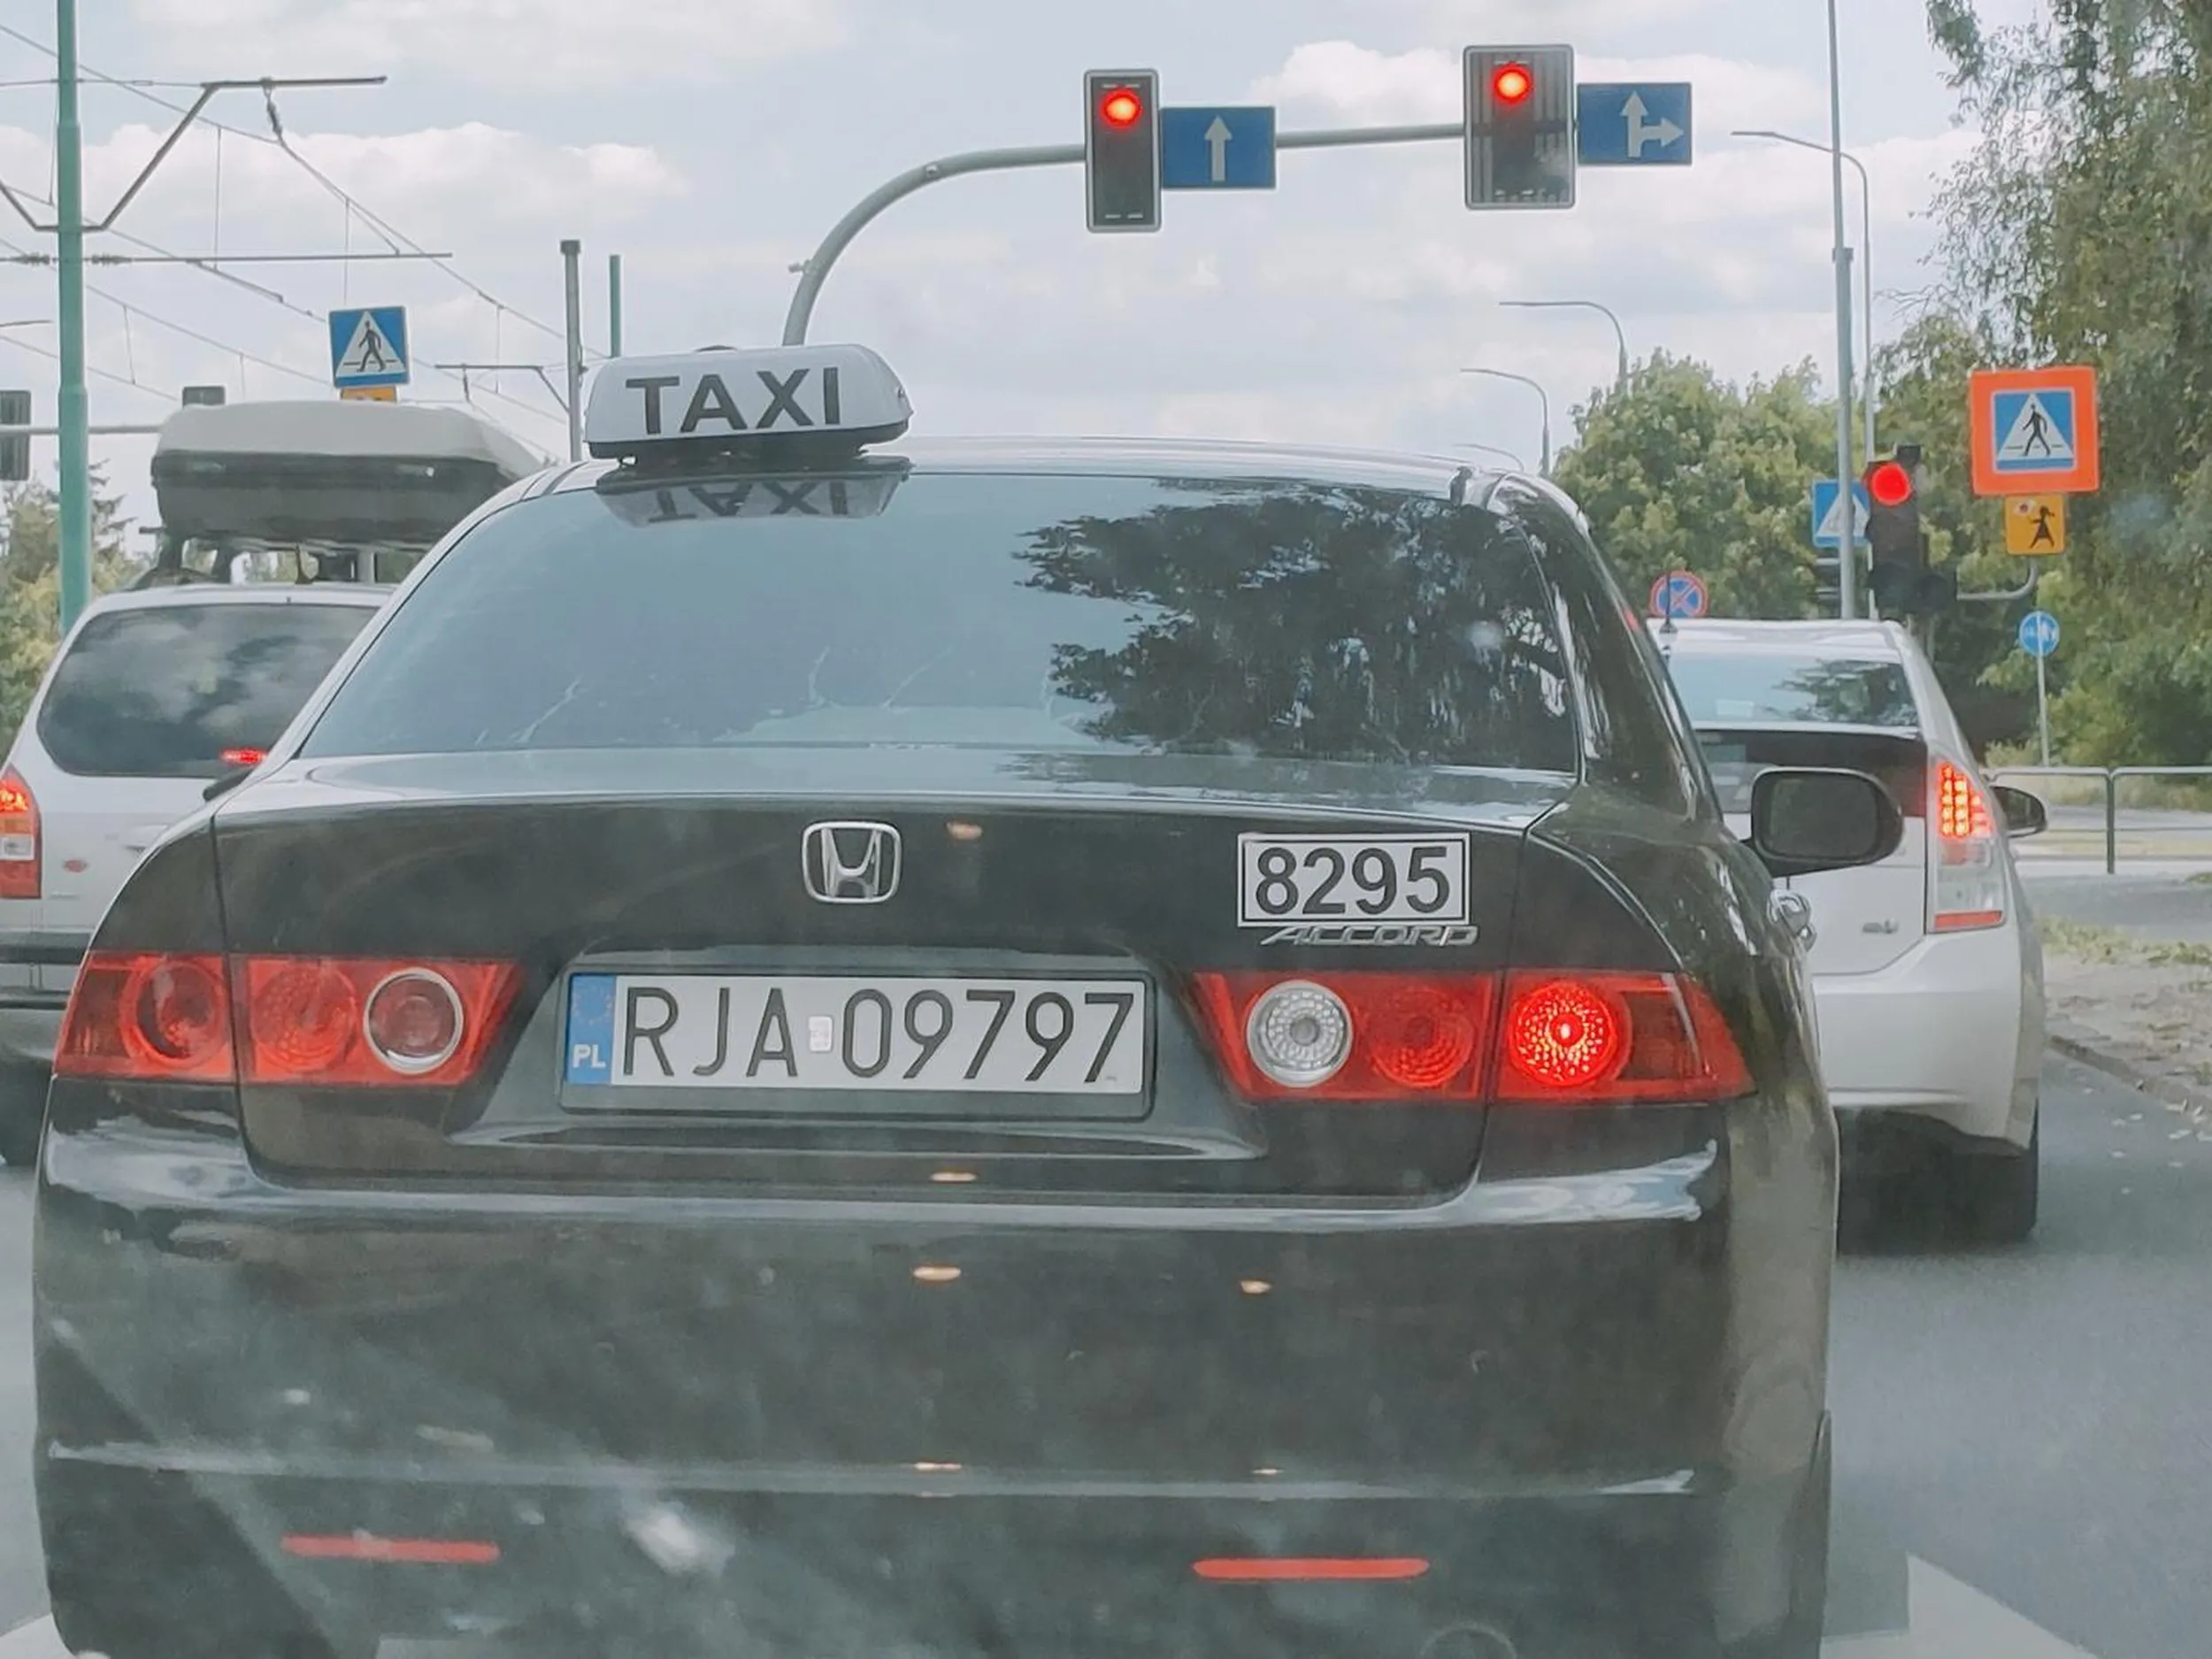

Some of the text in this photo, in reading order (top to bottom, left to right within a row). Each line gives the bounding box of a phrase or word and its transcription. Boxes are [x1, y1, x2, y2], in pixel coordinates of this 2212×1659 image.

[625, 366, 841, 434] TAXI
[1255, 846, 1451, 915] 8295
[1260, 925, 1479, 947] ACCORD
[572, 1043, 607, 1069] PL
[622, 986, 1135, 1083] RJA 09797
